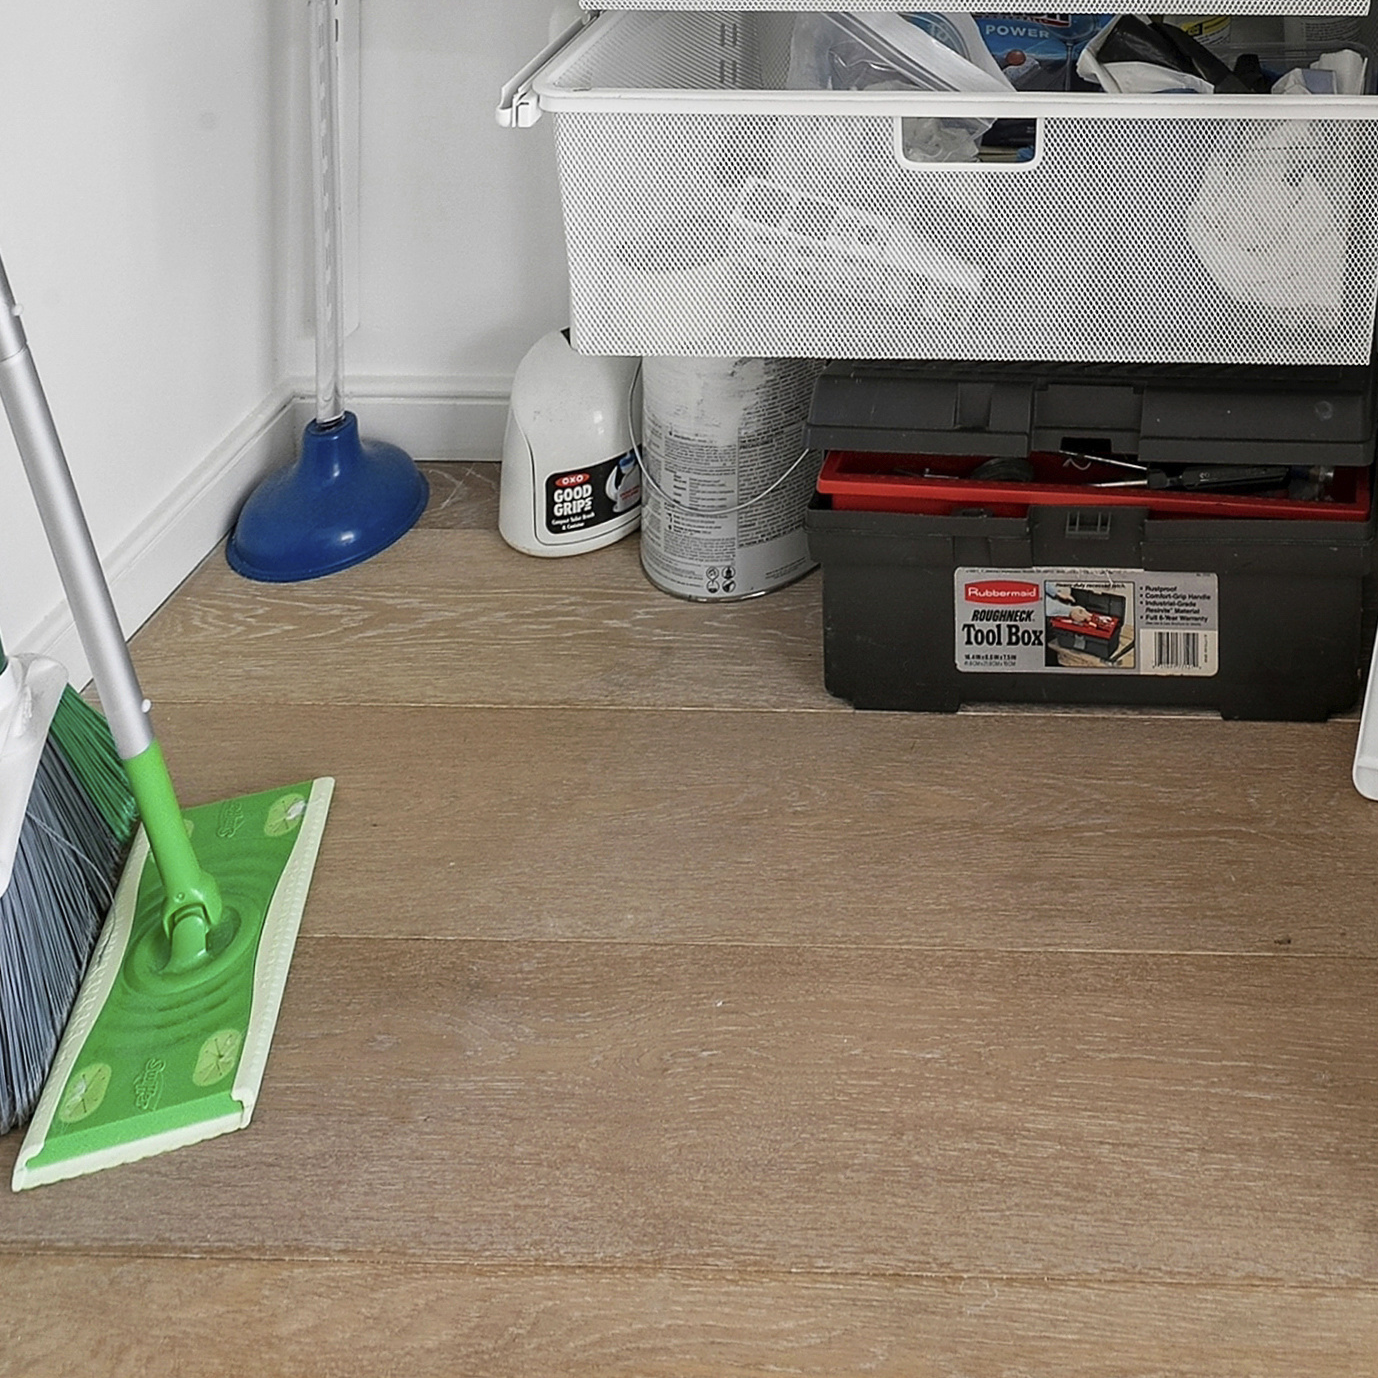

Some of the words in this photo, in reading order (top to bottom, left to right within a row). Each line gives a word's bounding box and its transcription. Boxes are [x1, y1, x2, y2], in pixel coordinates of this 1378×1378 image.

[985, 23, 1050, 39] POWER
[561, 474, 584, 485] OXO
[553, 484, 593, 503] GOOD
[553, 496, 594, 517] GRIPS
[967, 586, 1037, 598] Rubbermaid
[971, 609, 1035, 622] ROUGHNECK
[962, 623, 1003, 646] Tool
[1006, 623, 1044, 646] Box
